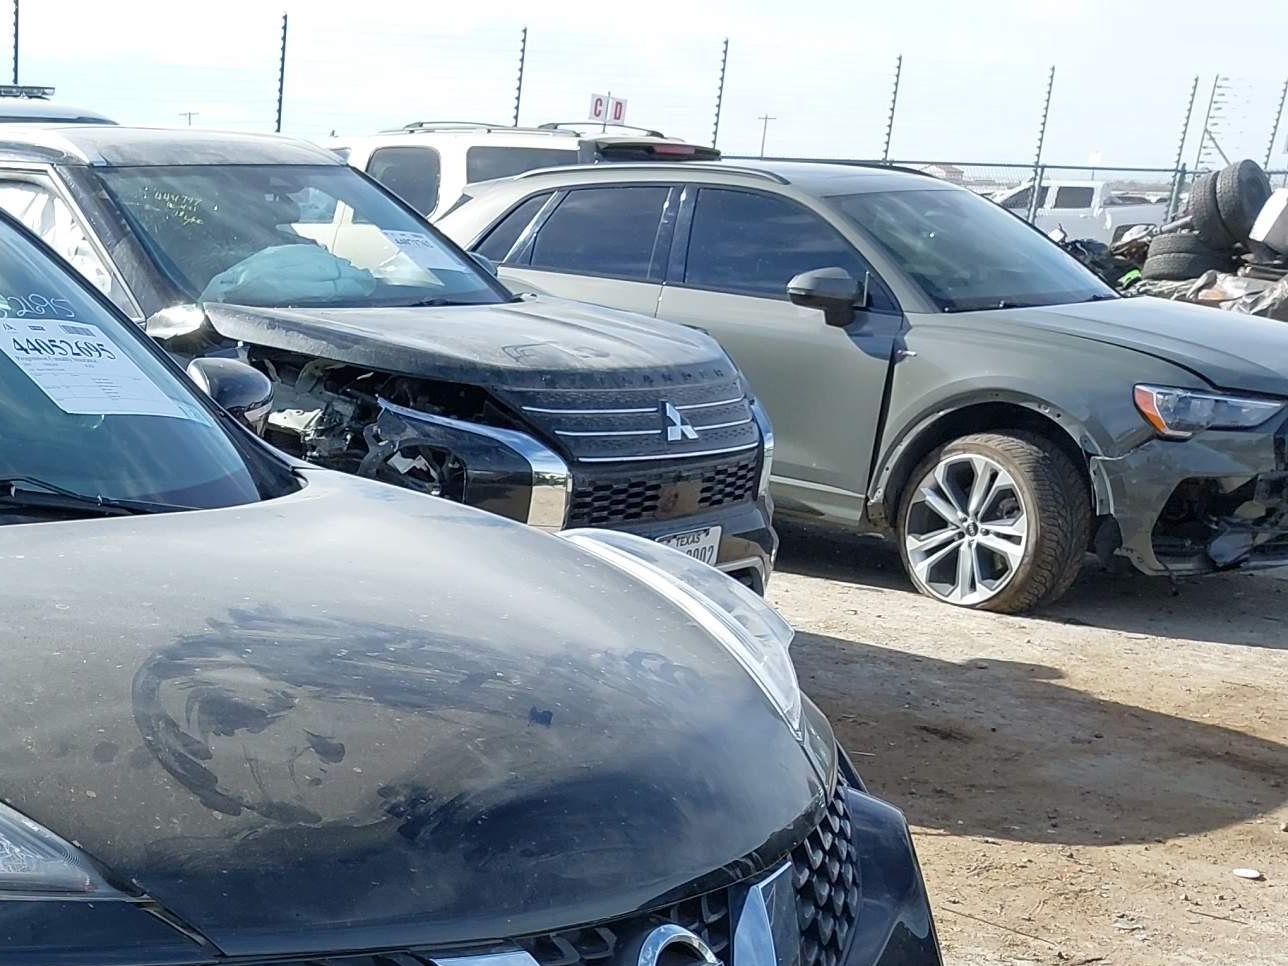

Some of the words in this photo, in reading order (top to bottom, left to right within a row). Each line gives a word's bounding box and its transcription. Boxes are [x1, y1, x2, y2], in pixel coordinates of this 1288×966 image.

[593, 97, 603, 117] C
[613, 101, 623, 120] D
[12, 337, 116, 360] 44052695
[676, 534, 701, 547] TEXAS
